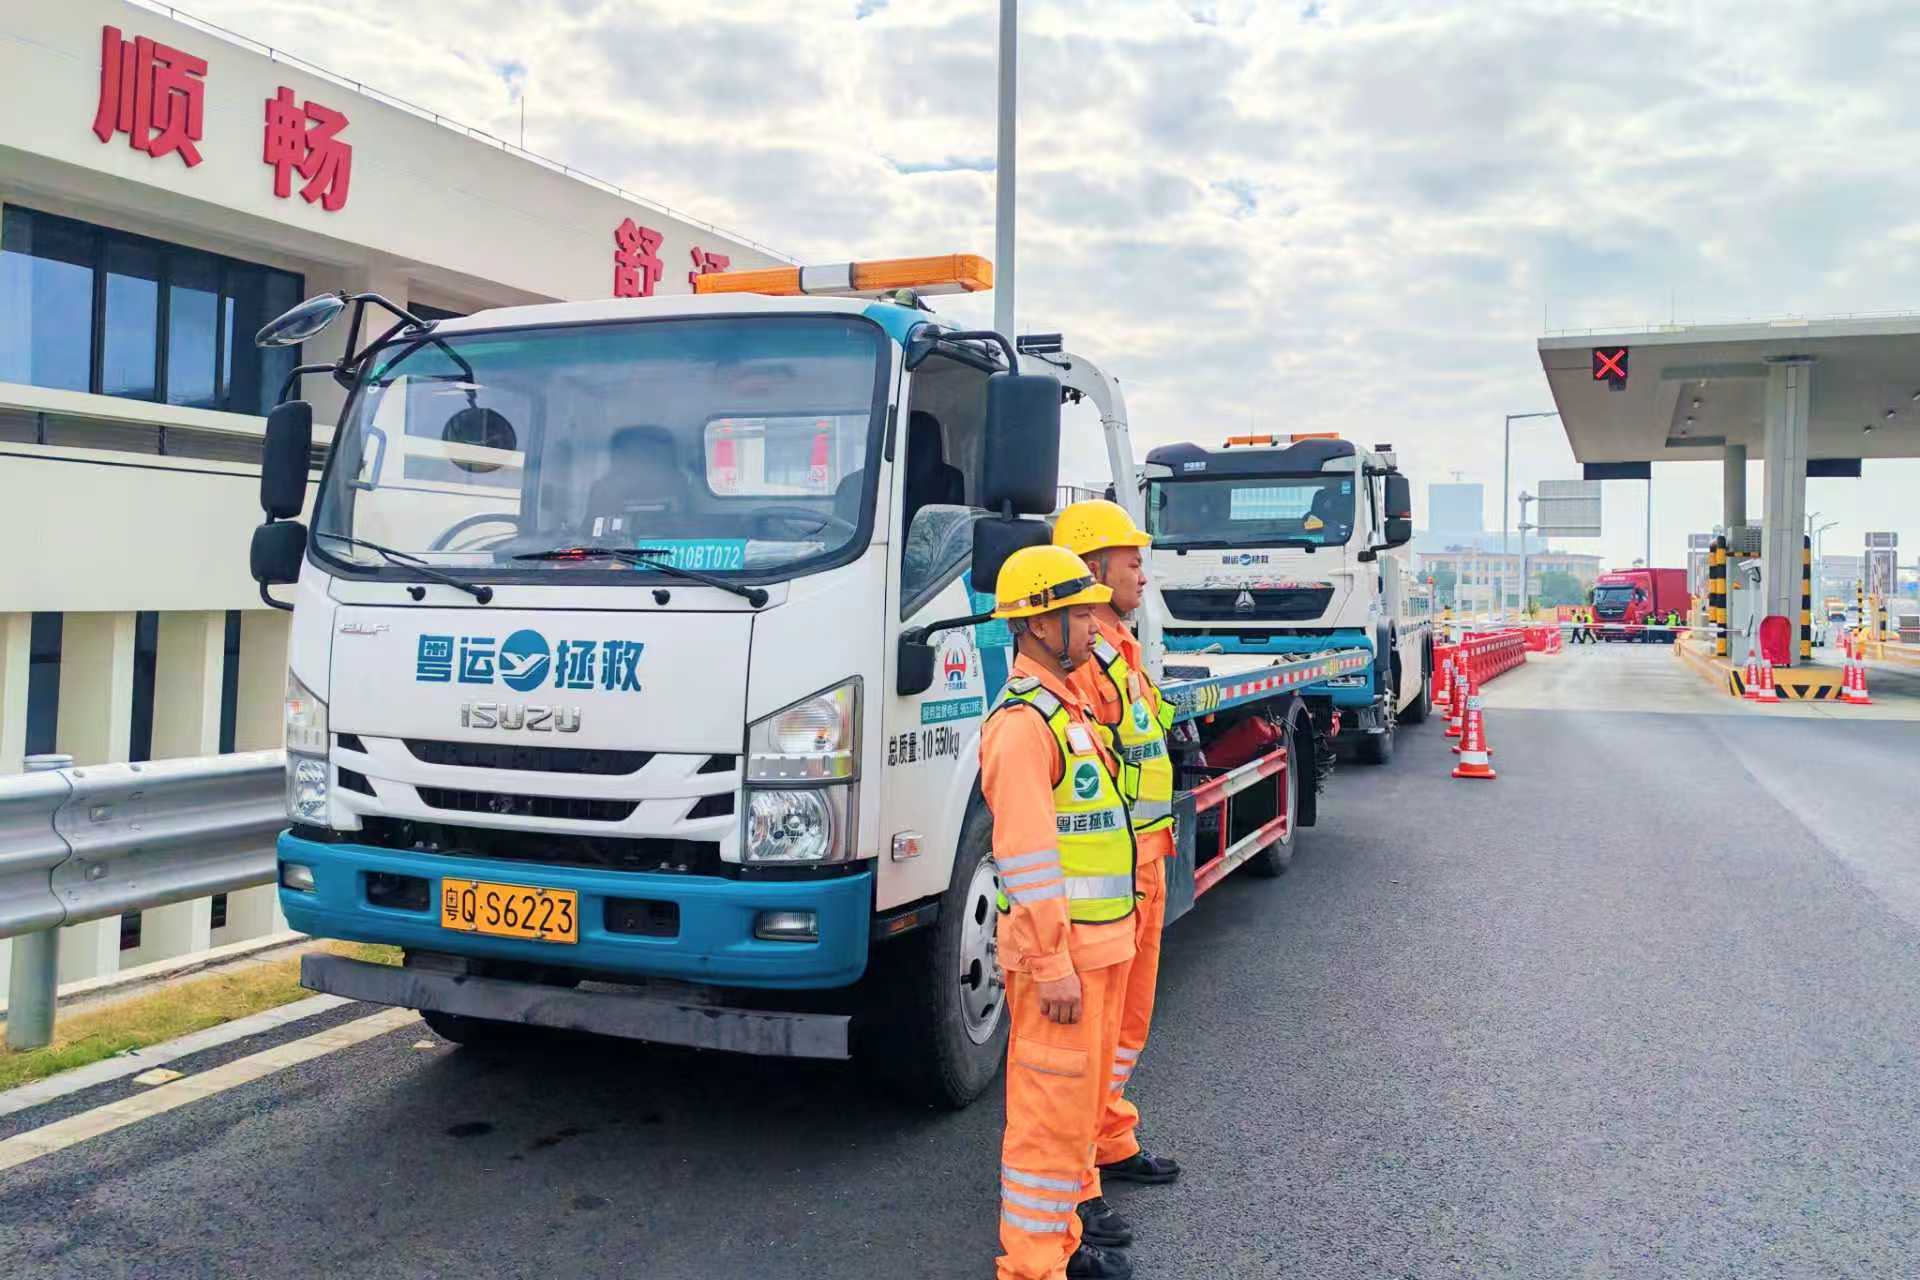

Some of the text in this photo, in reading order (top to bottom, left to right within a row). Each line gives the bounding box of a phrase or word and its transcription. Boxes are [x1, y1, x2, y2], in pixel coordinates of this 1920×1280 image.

[92, 25, 352, 212] 顺畅
[416, 634, 645, 692] 粤运 拯救
[461, 703, 581, 732] ISUZU
[1056, 810, 1116, 832] 粤运拯救
